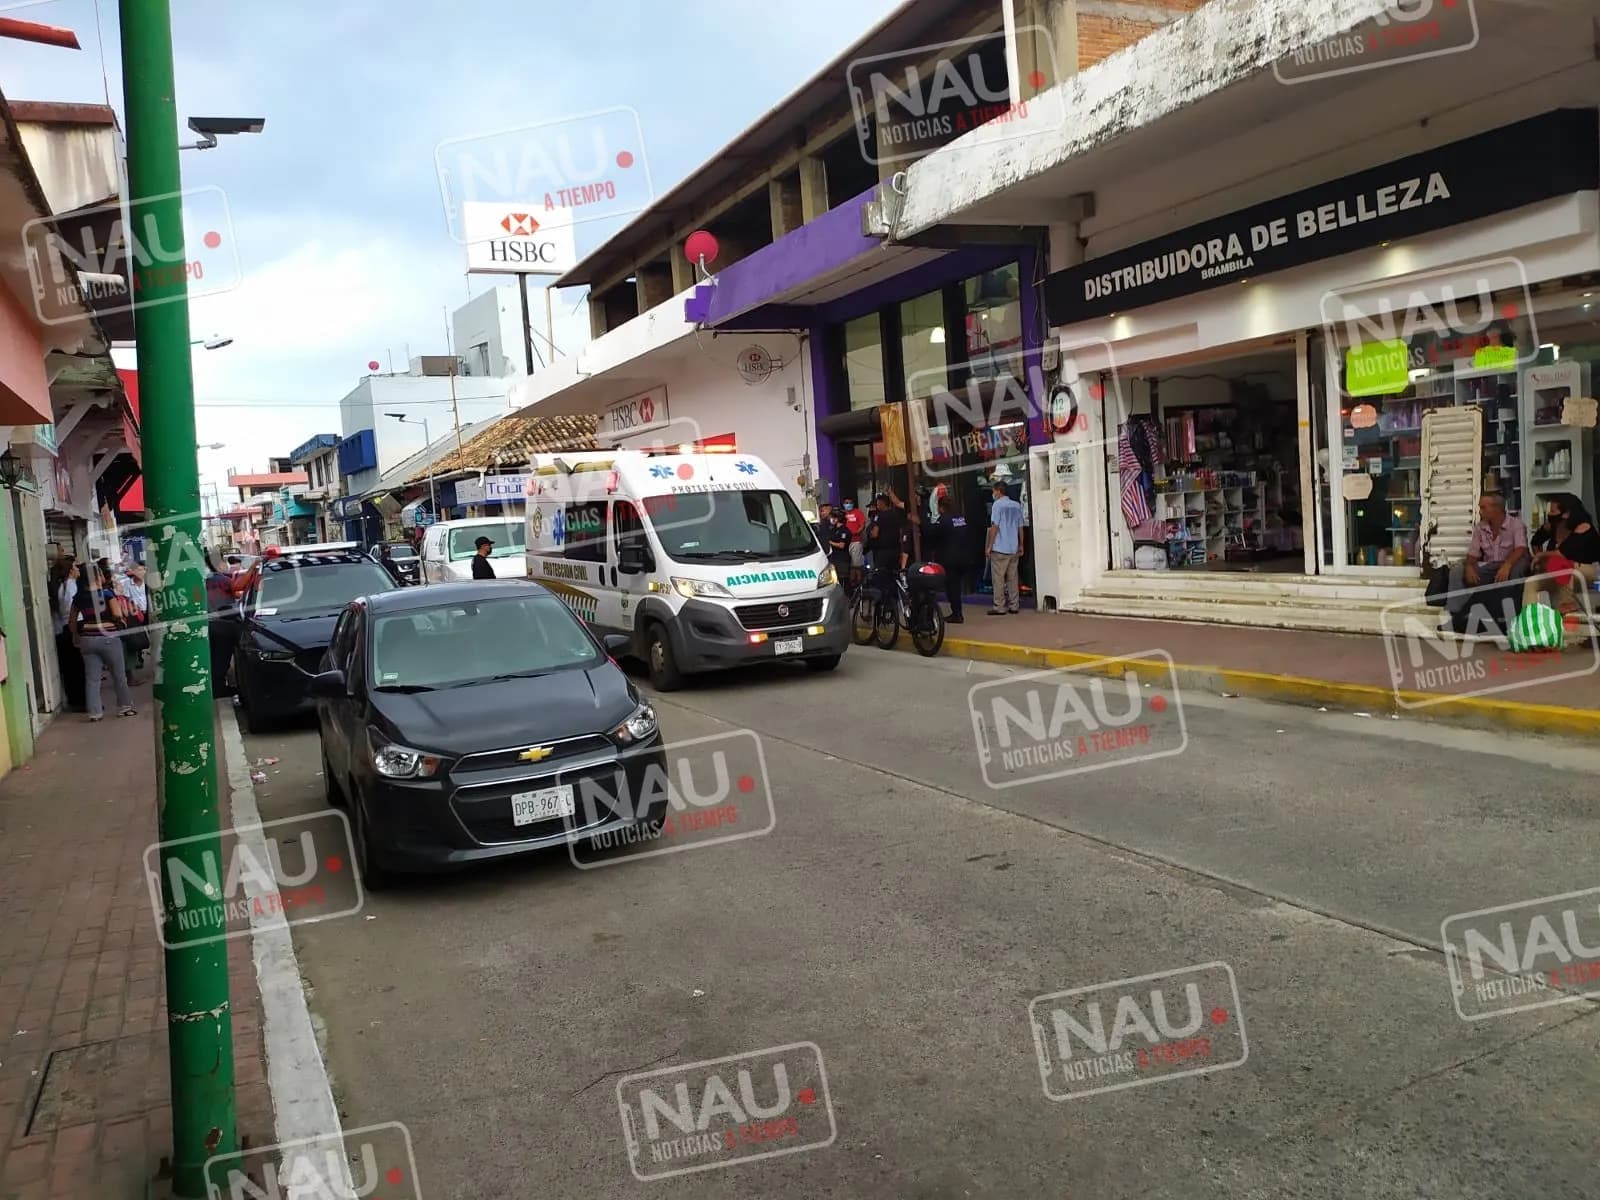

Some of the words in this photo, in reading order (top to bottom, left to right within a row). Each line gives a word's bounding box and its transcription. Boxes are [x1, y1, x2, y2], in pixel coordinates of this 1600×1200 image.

[1085, 233, 1243, 301] DISTRIBUIDORA
[1250, 219, 1288, 252] DE
[1297, 172, 1450, 239] BELLEZA
[490, 241, 556, 263] HSBC
[1201, 257, 1254, 280] BRAMBILA
[612, 404, 638, 431] HSBC
[543, 562, 574, 579] PROTECCION
[574, 565, 588, 581] CIVIL
